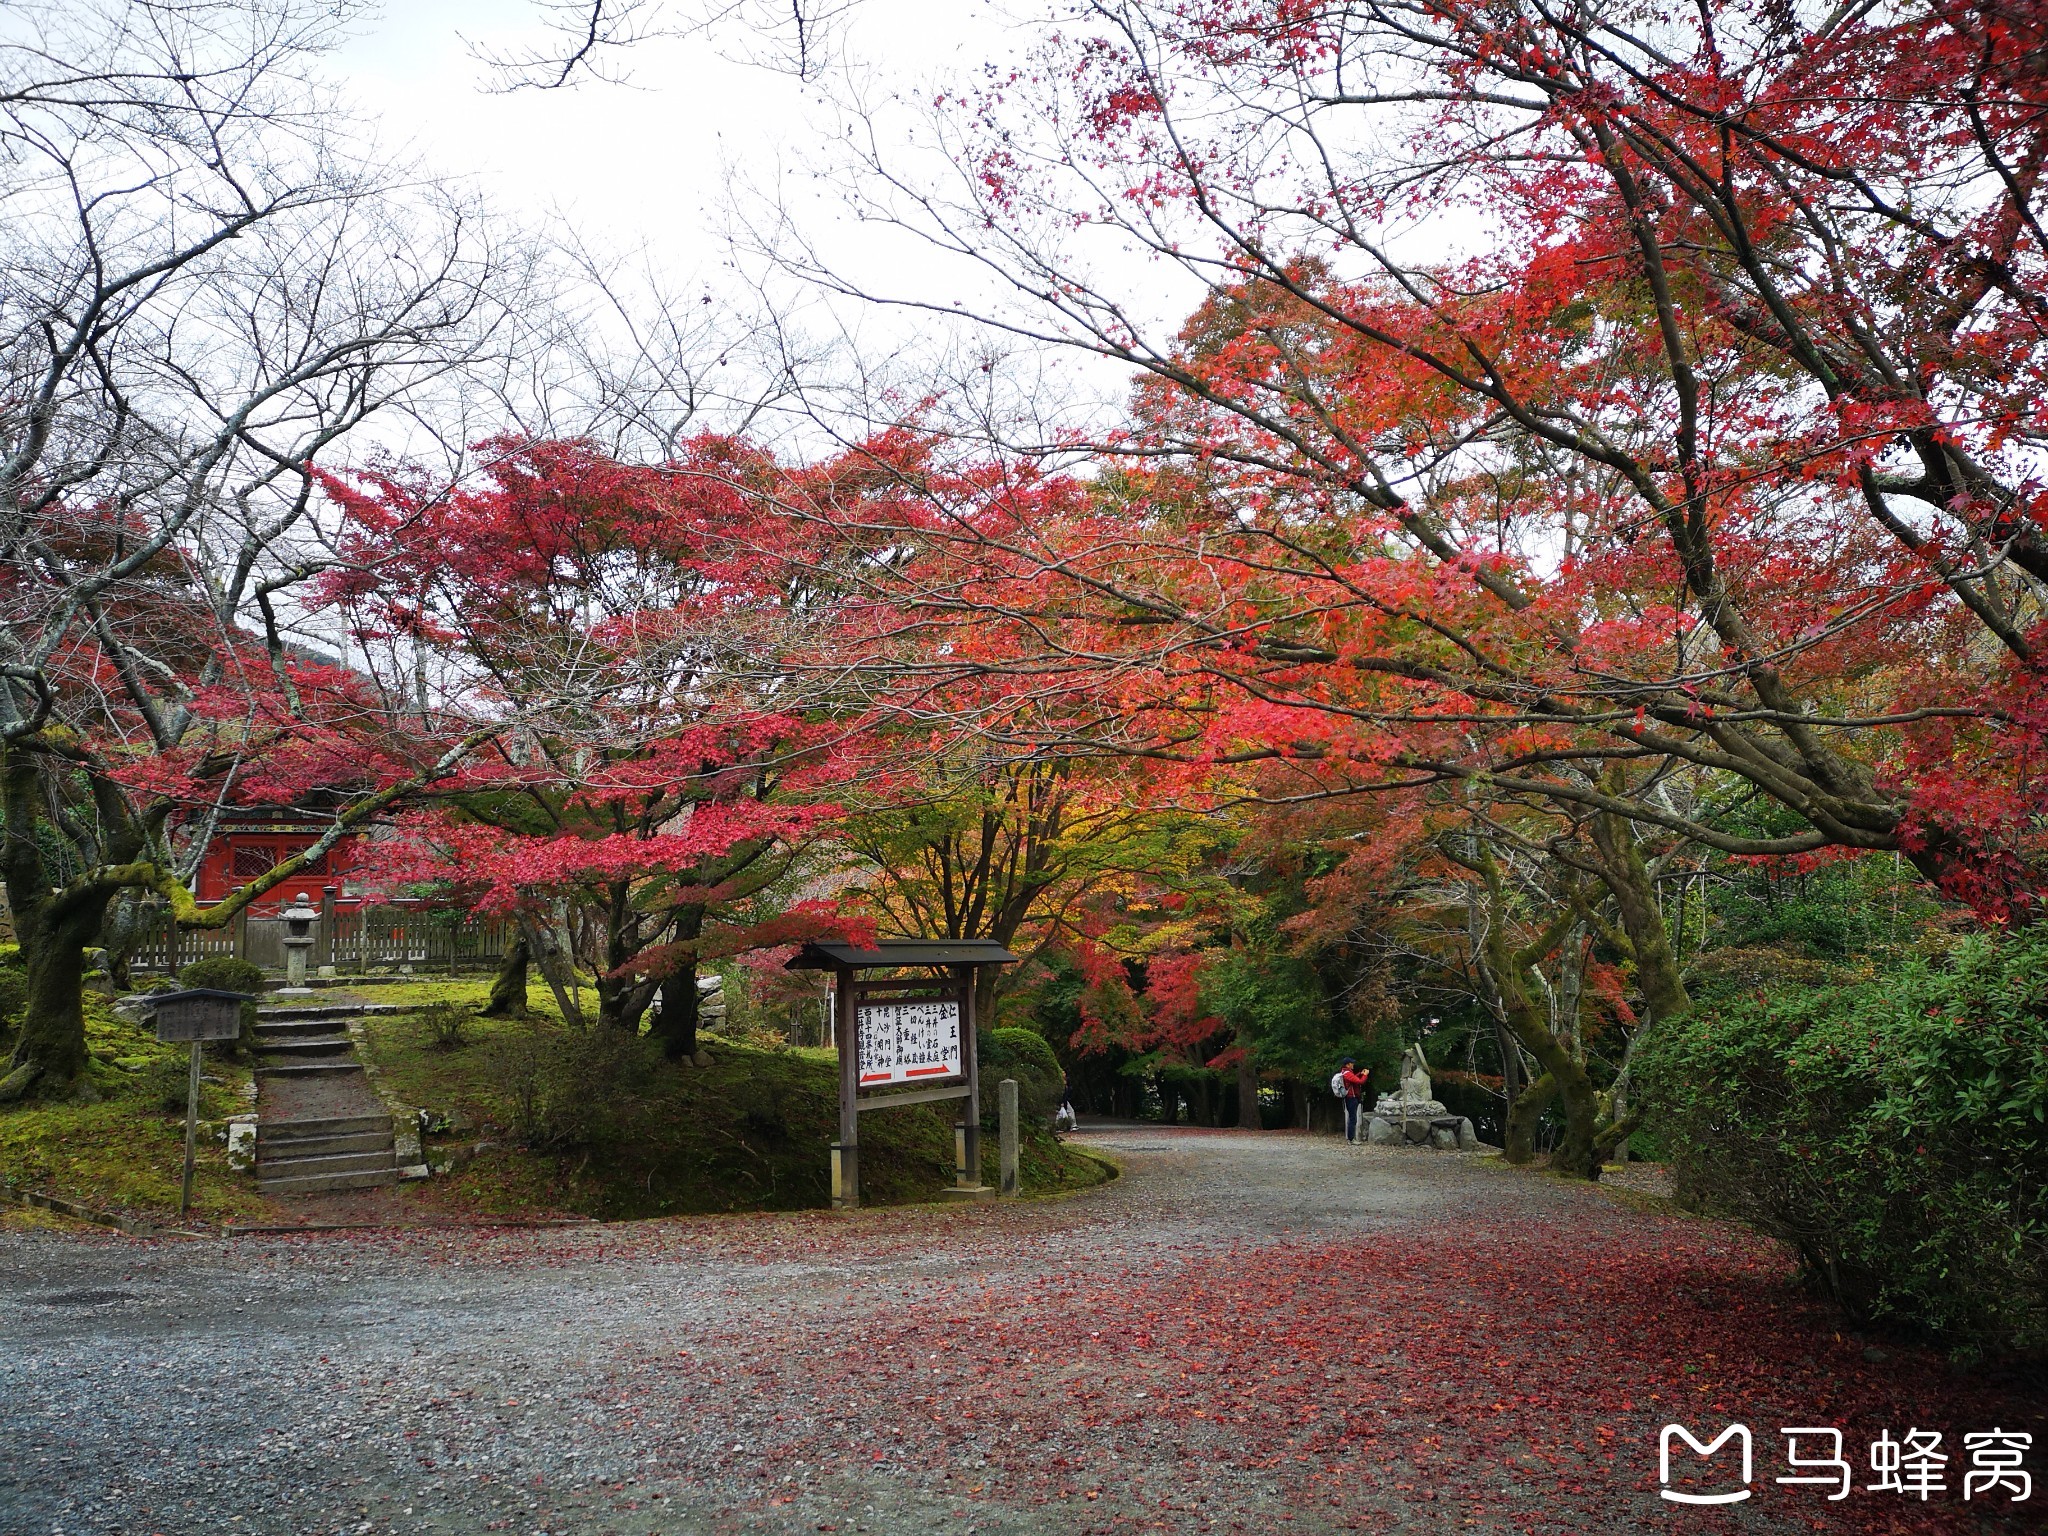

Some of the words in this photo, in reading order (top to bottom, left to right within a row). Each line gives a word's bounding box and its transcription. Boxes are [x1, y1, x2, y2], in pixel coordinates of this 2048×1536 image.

[939, 1004, 949, 1061] 金堂
[949, 1003, 958, 1060] 仁王門
